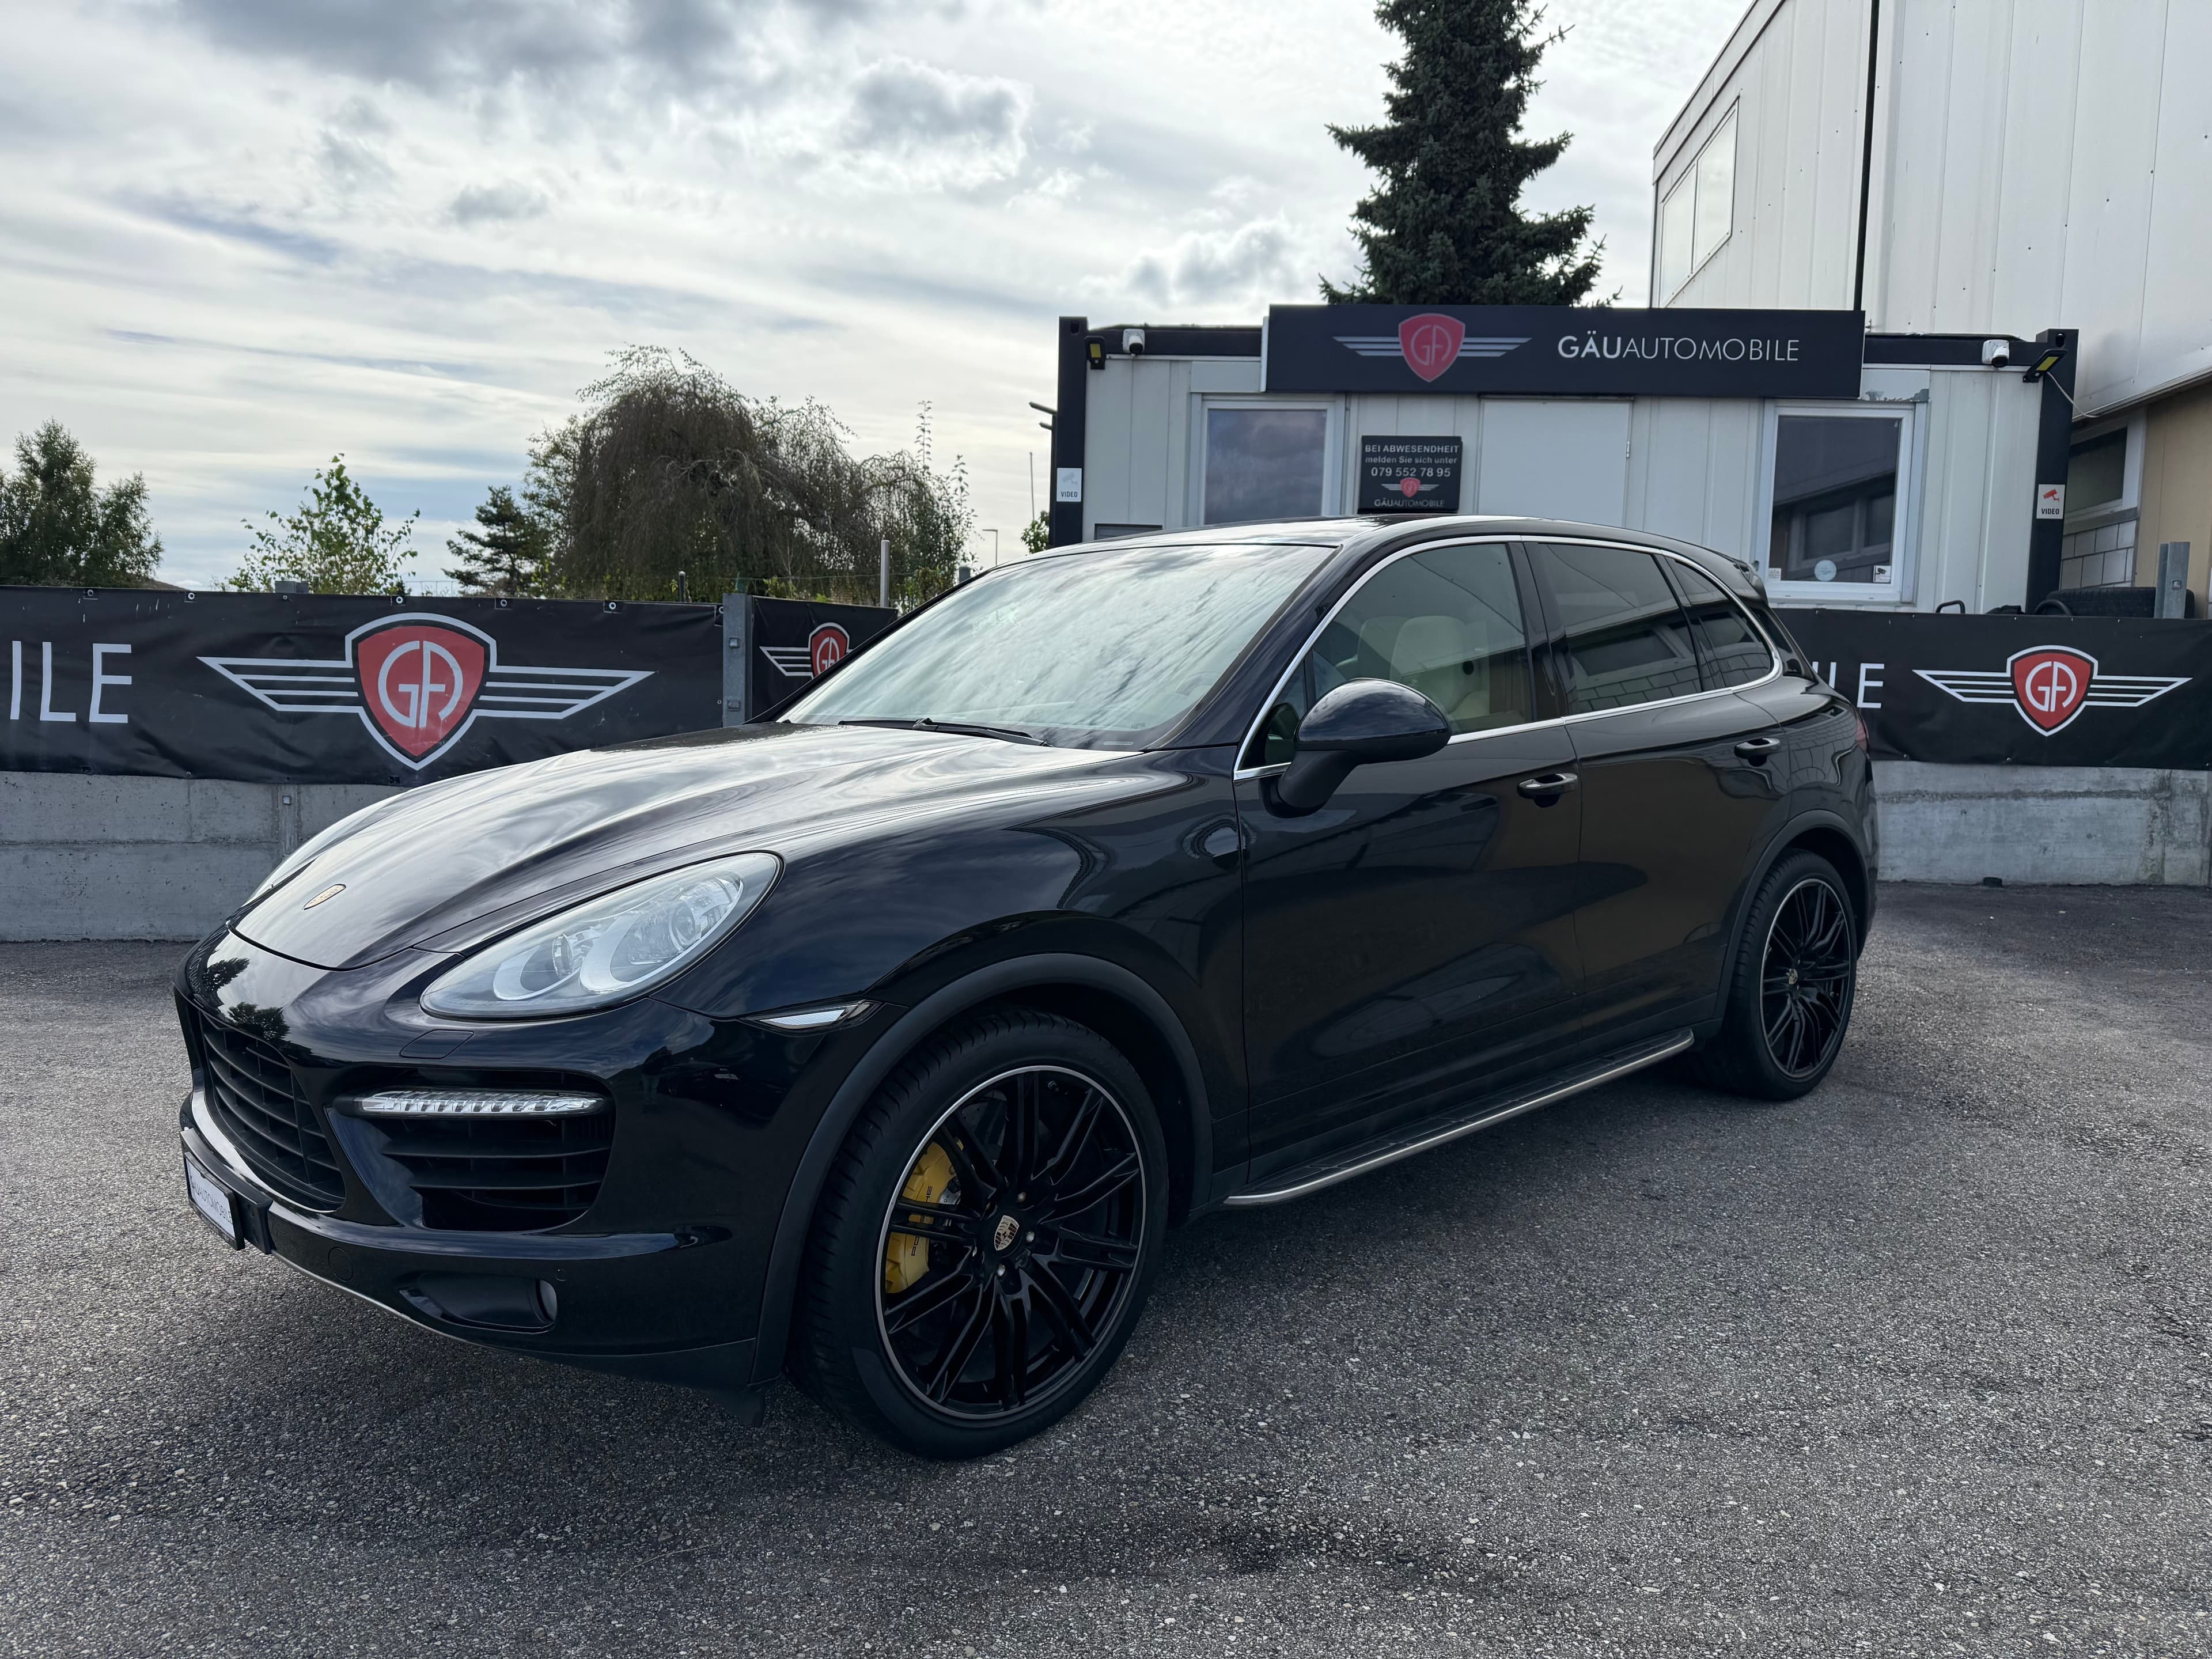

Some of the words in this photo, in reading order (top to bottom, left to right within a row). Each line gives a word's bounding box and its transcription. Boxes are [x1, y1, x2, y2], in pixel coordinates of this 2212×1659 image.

[1557, 329, 1800, 361] GÄUAUTOMOBILE
[1382, 445, 1460, 453] ABWESENDHEIT
[1365, 456, 1396, 464] melden
[1399, 456, 1412, 464] Sie
[1371, 467, 1392, 476] 079
[1395, 467, 1416, 477] 552
[1420, 468, 1434, 477] 78
[1437, 468, 1451, 477] 95
[1374, 498, 1445, 507] GÄUAUTOMOBILE
[378, 640, 464, 728] GA
[2025, 661, 2077, 712] GA
